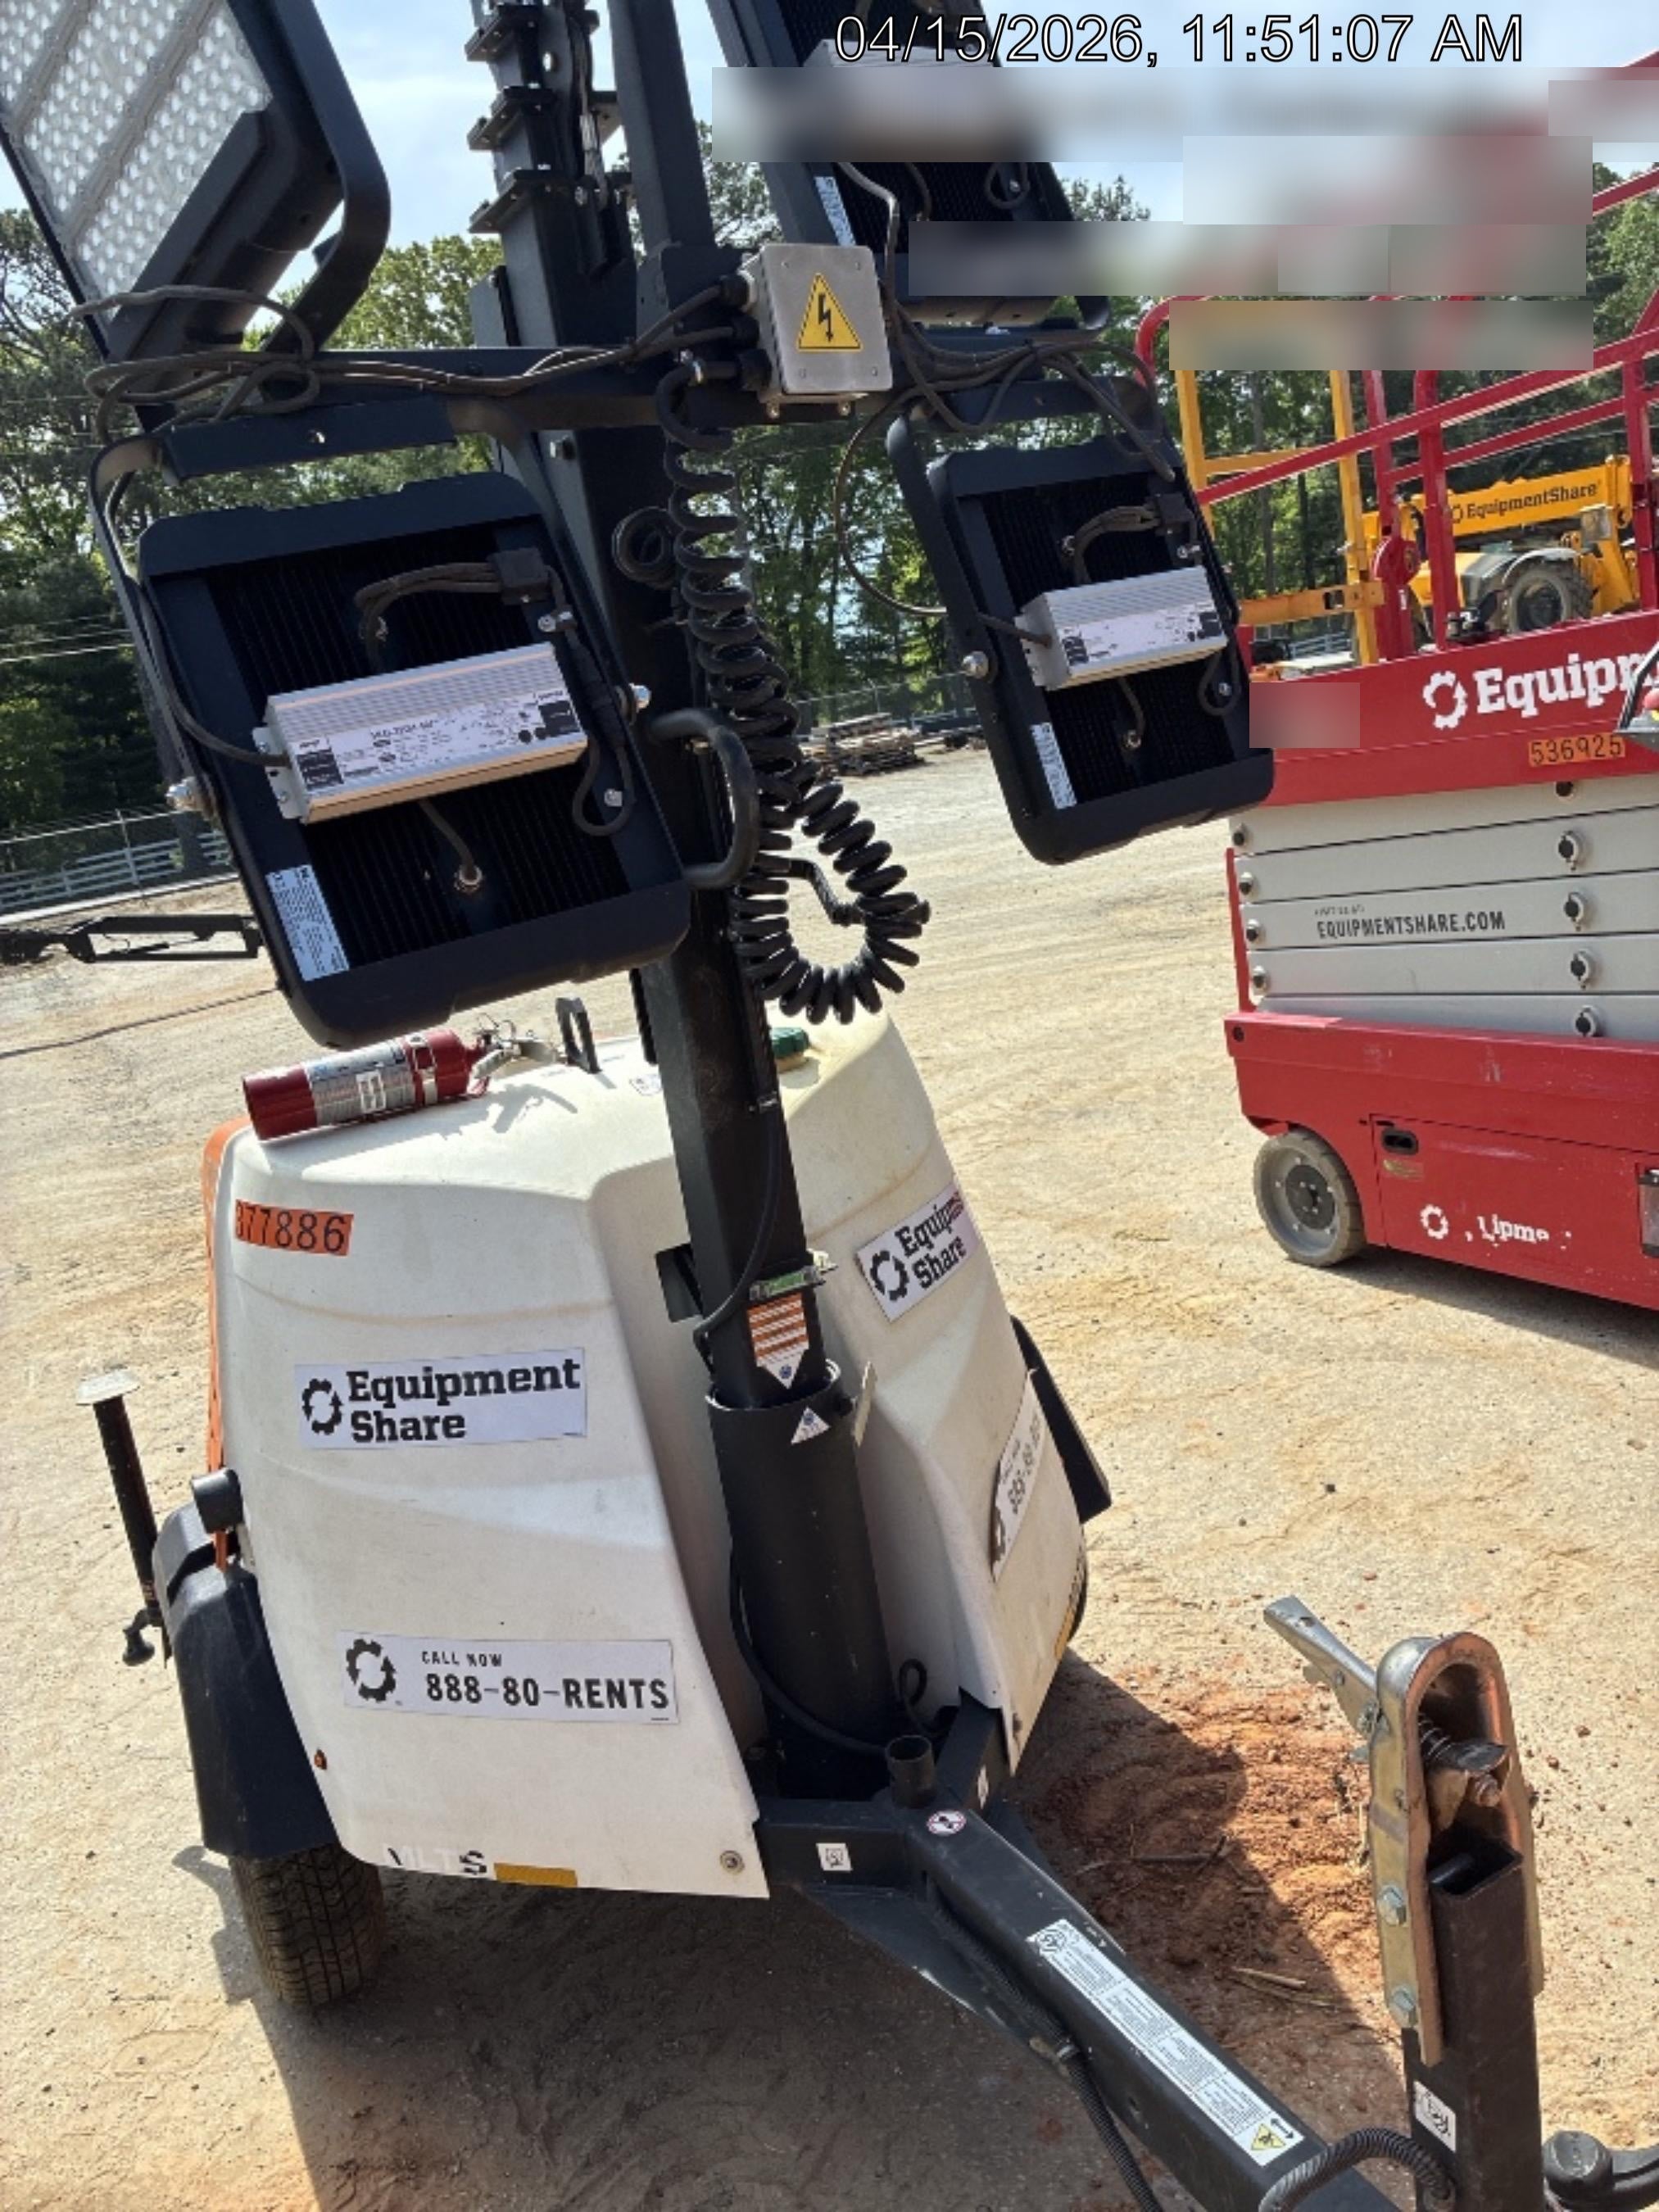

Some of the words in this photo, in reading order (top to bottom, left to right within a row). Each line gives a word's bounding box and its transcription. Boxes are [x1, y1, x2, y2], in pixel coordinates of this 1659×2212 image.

[1467, 483, 1597, 519] EquipmentShare
[1530, 734, 1622, 765] 536925
[1317, 910, 1506, 939] EQUIPMENTSHARE.COM
[913, 1235, 967, 1289] Share
[346, 1358, 581, 1409] Equipment
[350, 1410, 467, 1444] Share
[422, 1650, 460, 1665] CALL
[465, 1653, 502, 1667] NOW
[425, 1673, 670, 1709] 888-80-RENTS
